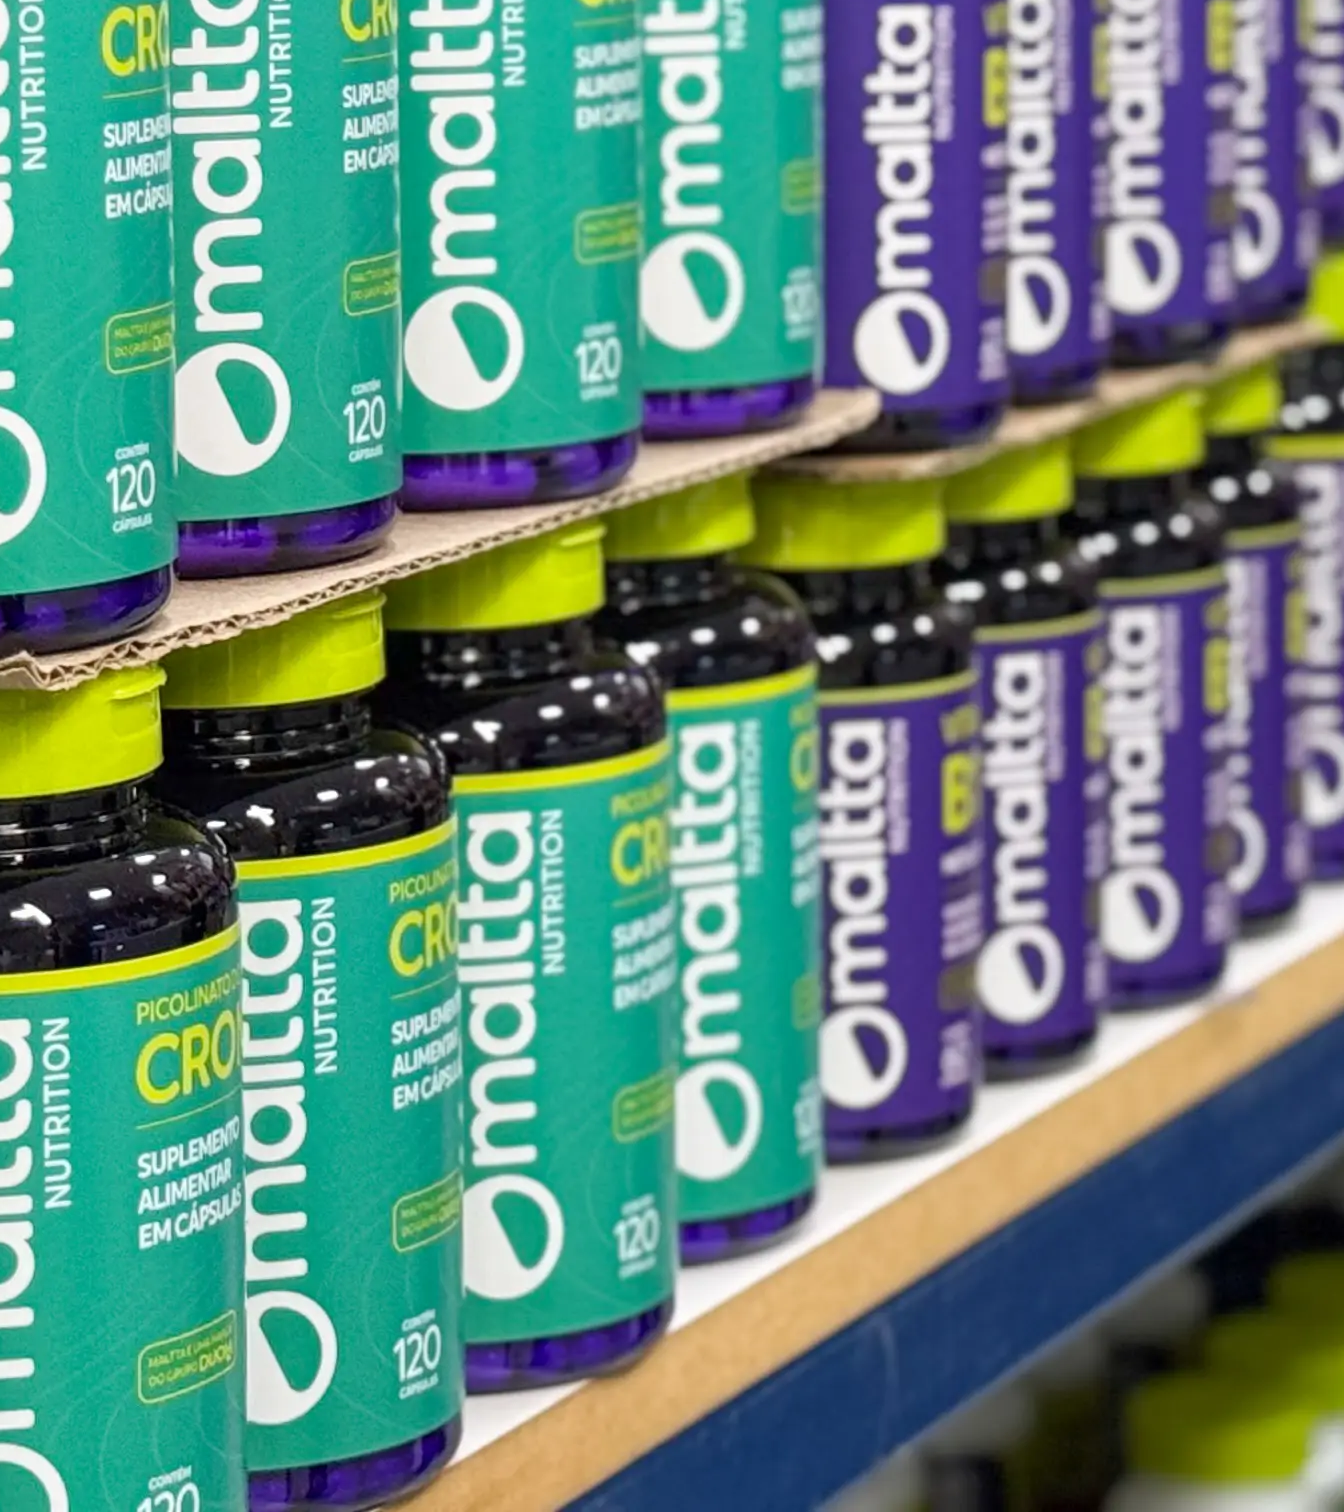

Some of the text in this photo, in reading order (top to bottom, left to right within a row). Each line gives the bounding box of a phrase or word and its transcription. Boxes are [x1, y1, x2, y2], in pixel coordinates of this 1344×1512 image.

[344, 150, 367, 174] EM
[863, 4, 933, 288] maltta
[106, 193, 131, 219] EM
[575, 338, 621, 380] 120
[343, 395, 385, 444] 120
[106, 459, 155, 513] 120
[671, 721, 742, 1057] maltta
[819, 719, 887, 1003] maltta
[540, 809, 567, 976] NUTRITION
[137, 973, 230, 1025] PICOLINATO
[311, 896, 337, 1075] NUTRITION
[458, 810, 537, 1167] maltta
[136, 1001, 241, 1104] CRO
[43, 1016, 70, 1208] NUTRITION
[393, 1082, 418, 1110] EM
[138, 1115, 239, 1179] SUPLEMENTO
[138, 1157, 231, 1215] ALIMENTAR
[139, 1183, 242, 1250] EM CÁPSULAS
[615, 1208, 660, 1265] 120
[393, 1324, 441, 1382] 120
